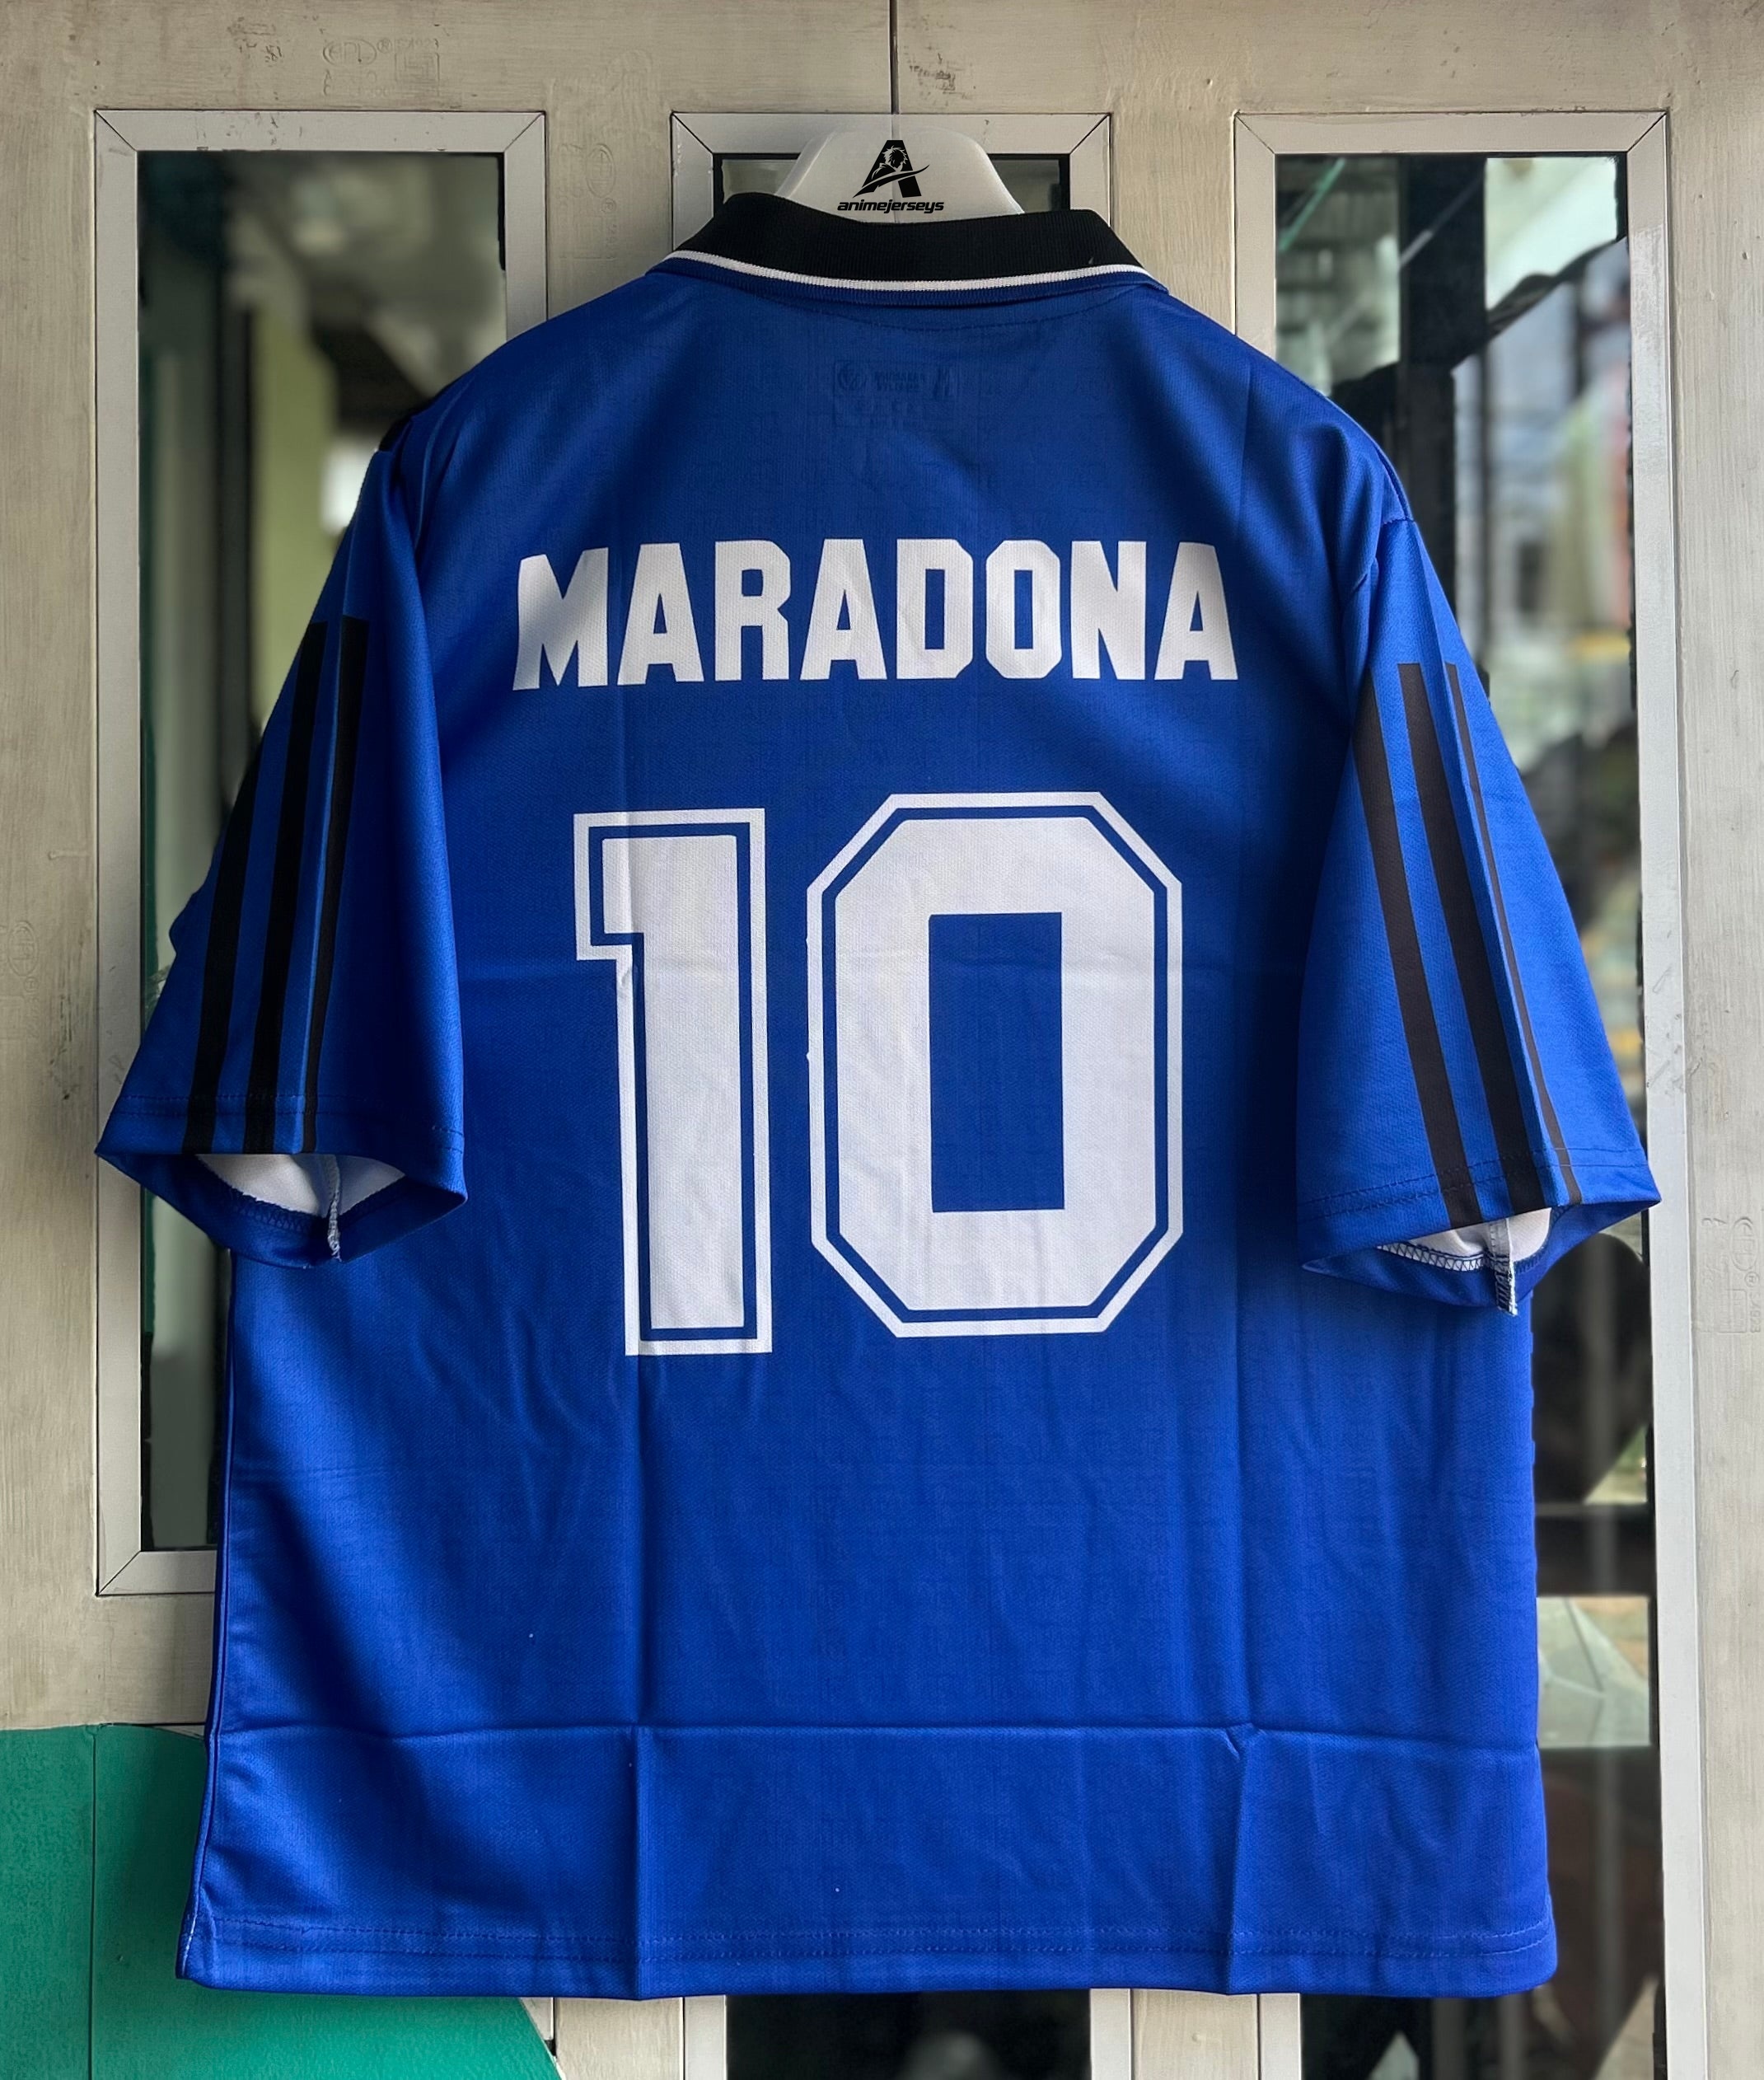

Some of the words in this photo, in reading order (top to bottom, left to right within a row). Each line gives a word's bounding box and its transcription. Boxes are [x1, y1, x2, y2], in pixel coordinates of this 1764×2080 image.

[837, 199, 944, 213] animejerseys
[514, 537, 1239, 690] MARADONA
[573, 791, 1184, 1356] 10
